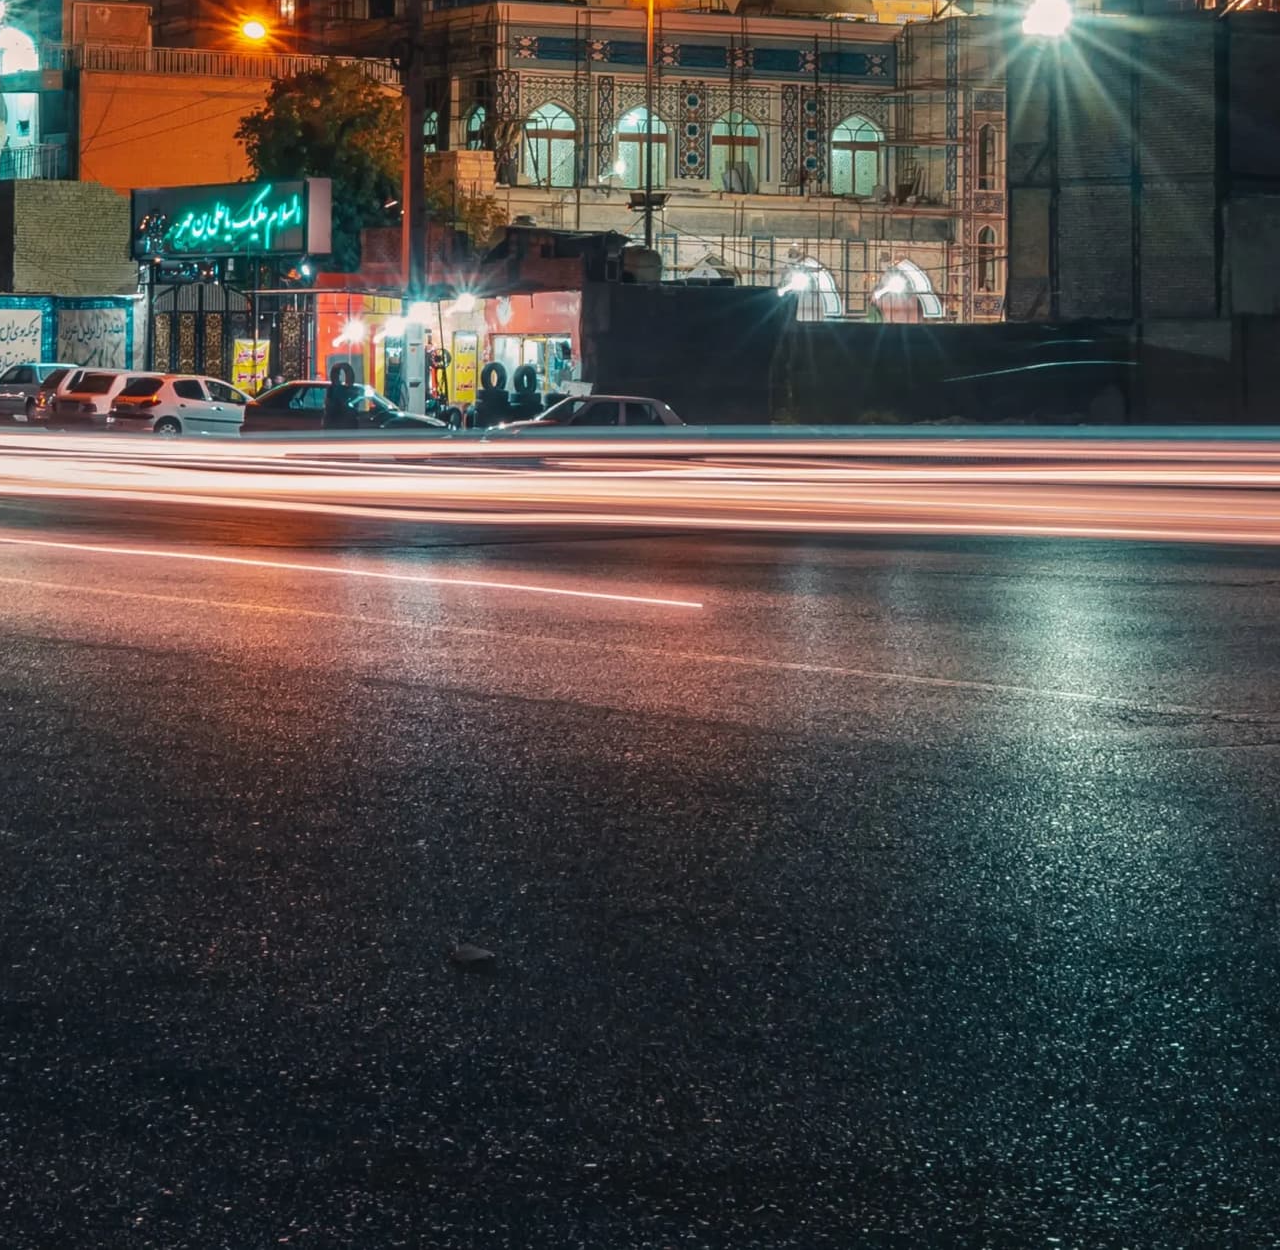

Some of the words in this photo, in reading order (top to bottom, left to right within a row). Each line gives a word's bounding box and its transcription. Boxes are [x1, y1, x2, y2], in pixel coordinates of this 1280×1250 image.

[191, 212, 209, 241] بن
[207, 201, 225, 236] علی
[223, 206, 233, 242] یا
[231, 183, 272, 240] علیک
[263, 193, 301, 250] السلام
